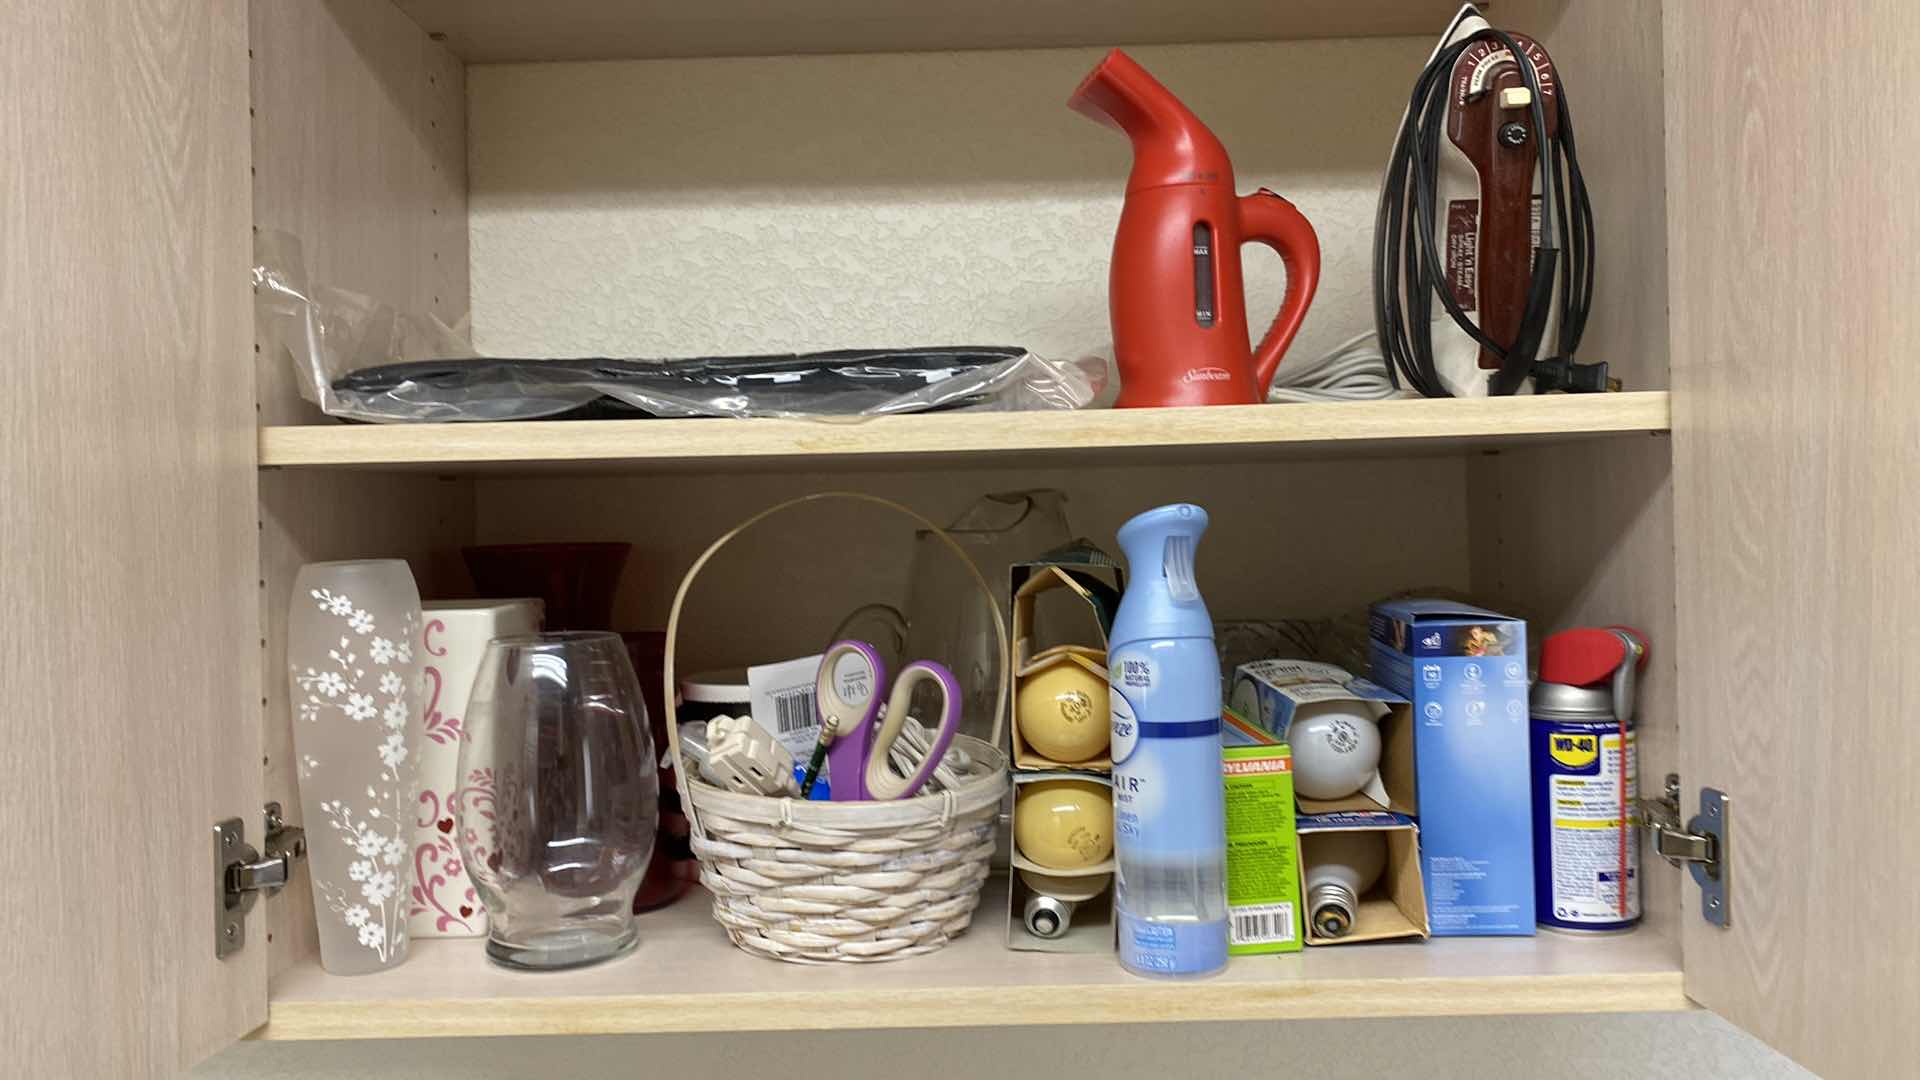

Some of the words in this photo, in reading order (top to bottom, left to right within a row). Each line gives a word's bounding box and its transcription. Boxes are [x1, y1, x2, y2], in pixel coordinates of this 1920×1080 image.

[1533, 52, 1543, 61] 5
[1540, 72, 1550, 80] 6
[1194, 248, 1209, 256] MAX
[1464, 232, 1476, 257] Light
[1462, 267, 1474, 289] Easy
[1183, 367, 1232, 384] Sunbeam
[1123, 660, 1151, 675] 100%
[1553, 737, 1594, 752] WD-40
